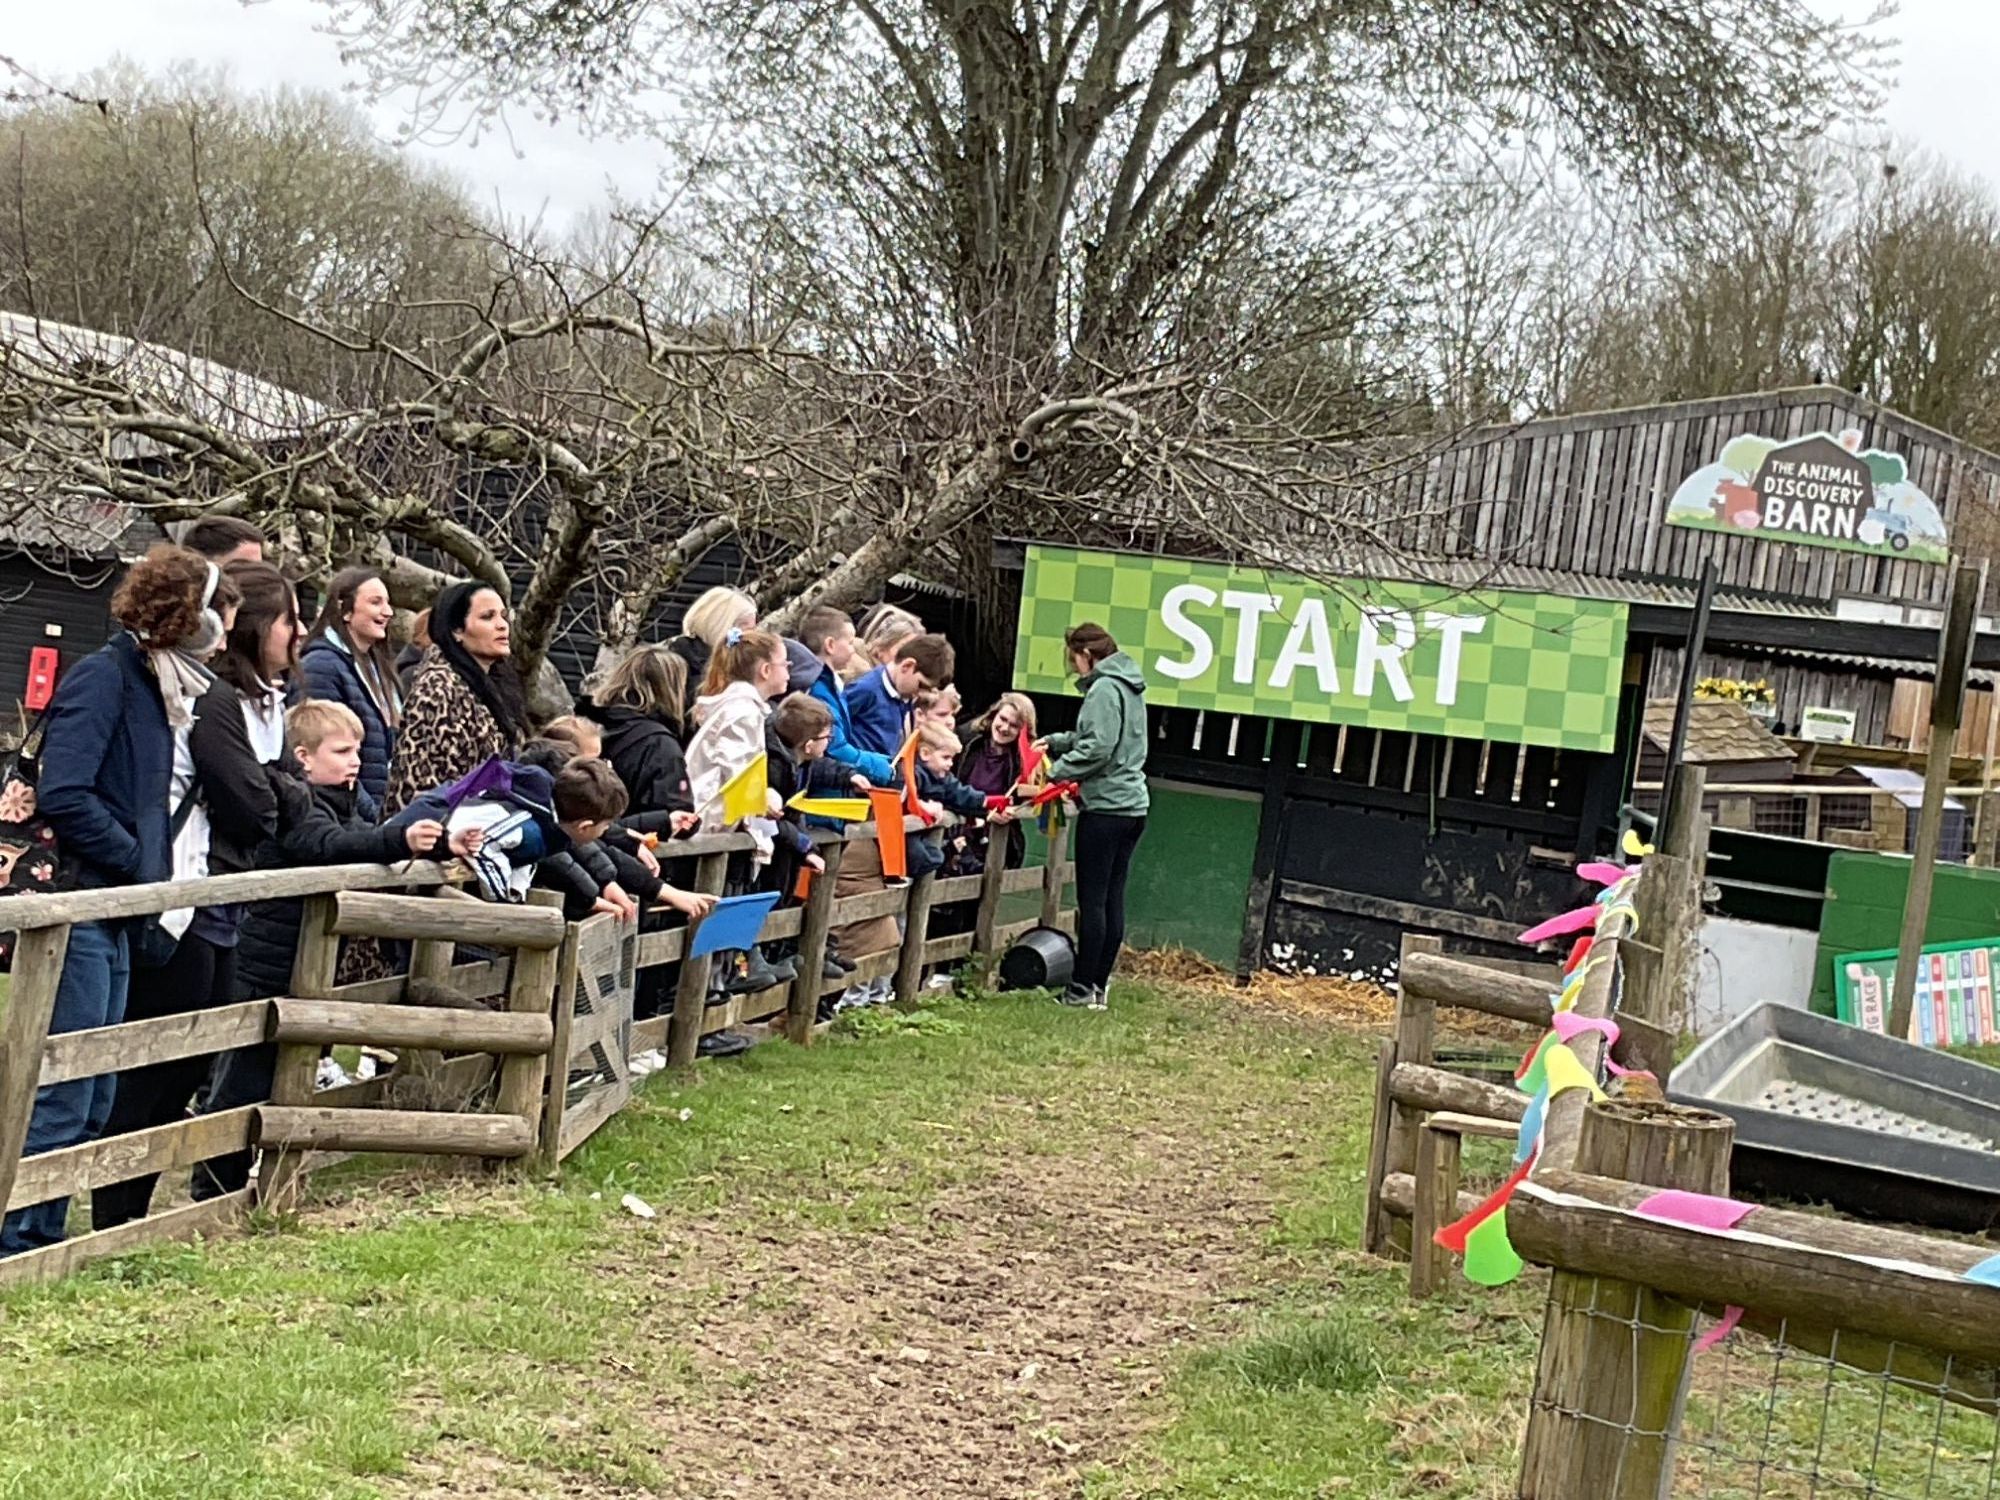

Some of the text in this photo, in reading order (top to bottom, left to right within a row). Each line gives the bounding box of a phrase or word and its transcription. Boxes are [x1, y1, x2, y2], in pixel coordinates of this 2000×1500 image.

[1772, 460, 1862, 486] THE ANIMAL
[1764, 476, 1864, 505] DISCOVERY
[1763, 496, 1856, 539] BARN
[1154, 583, 1487, 706] START
[1863, 981, 1877, 1012] RACE
